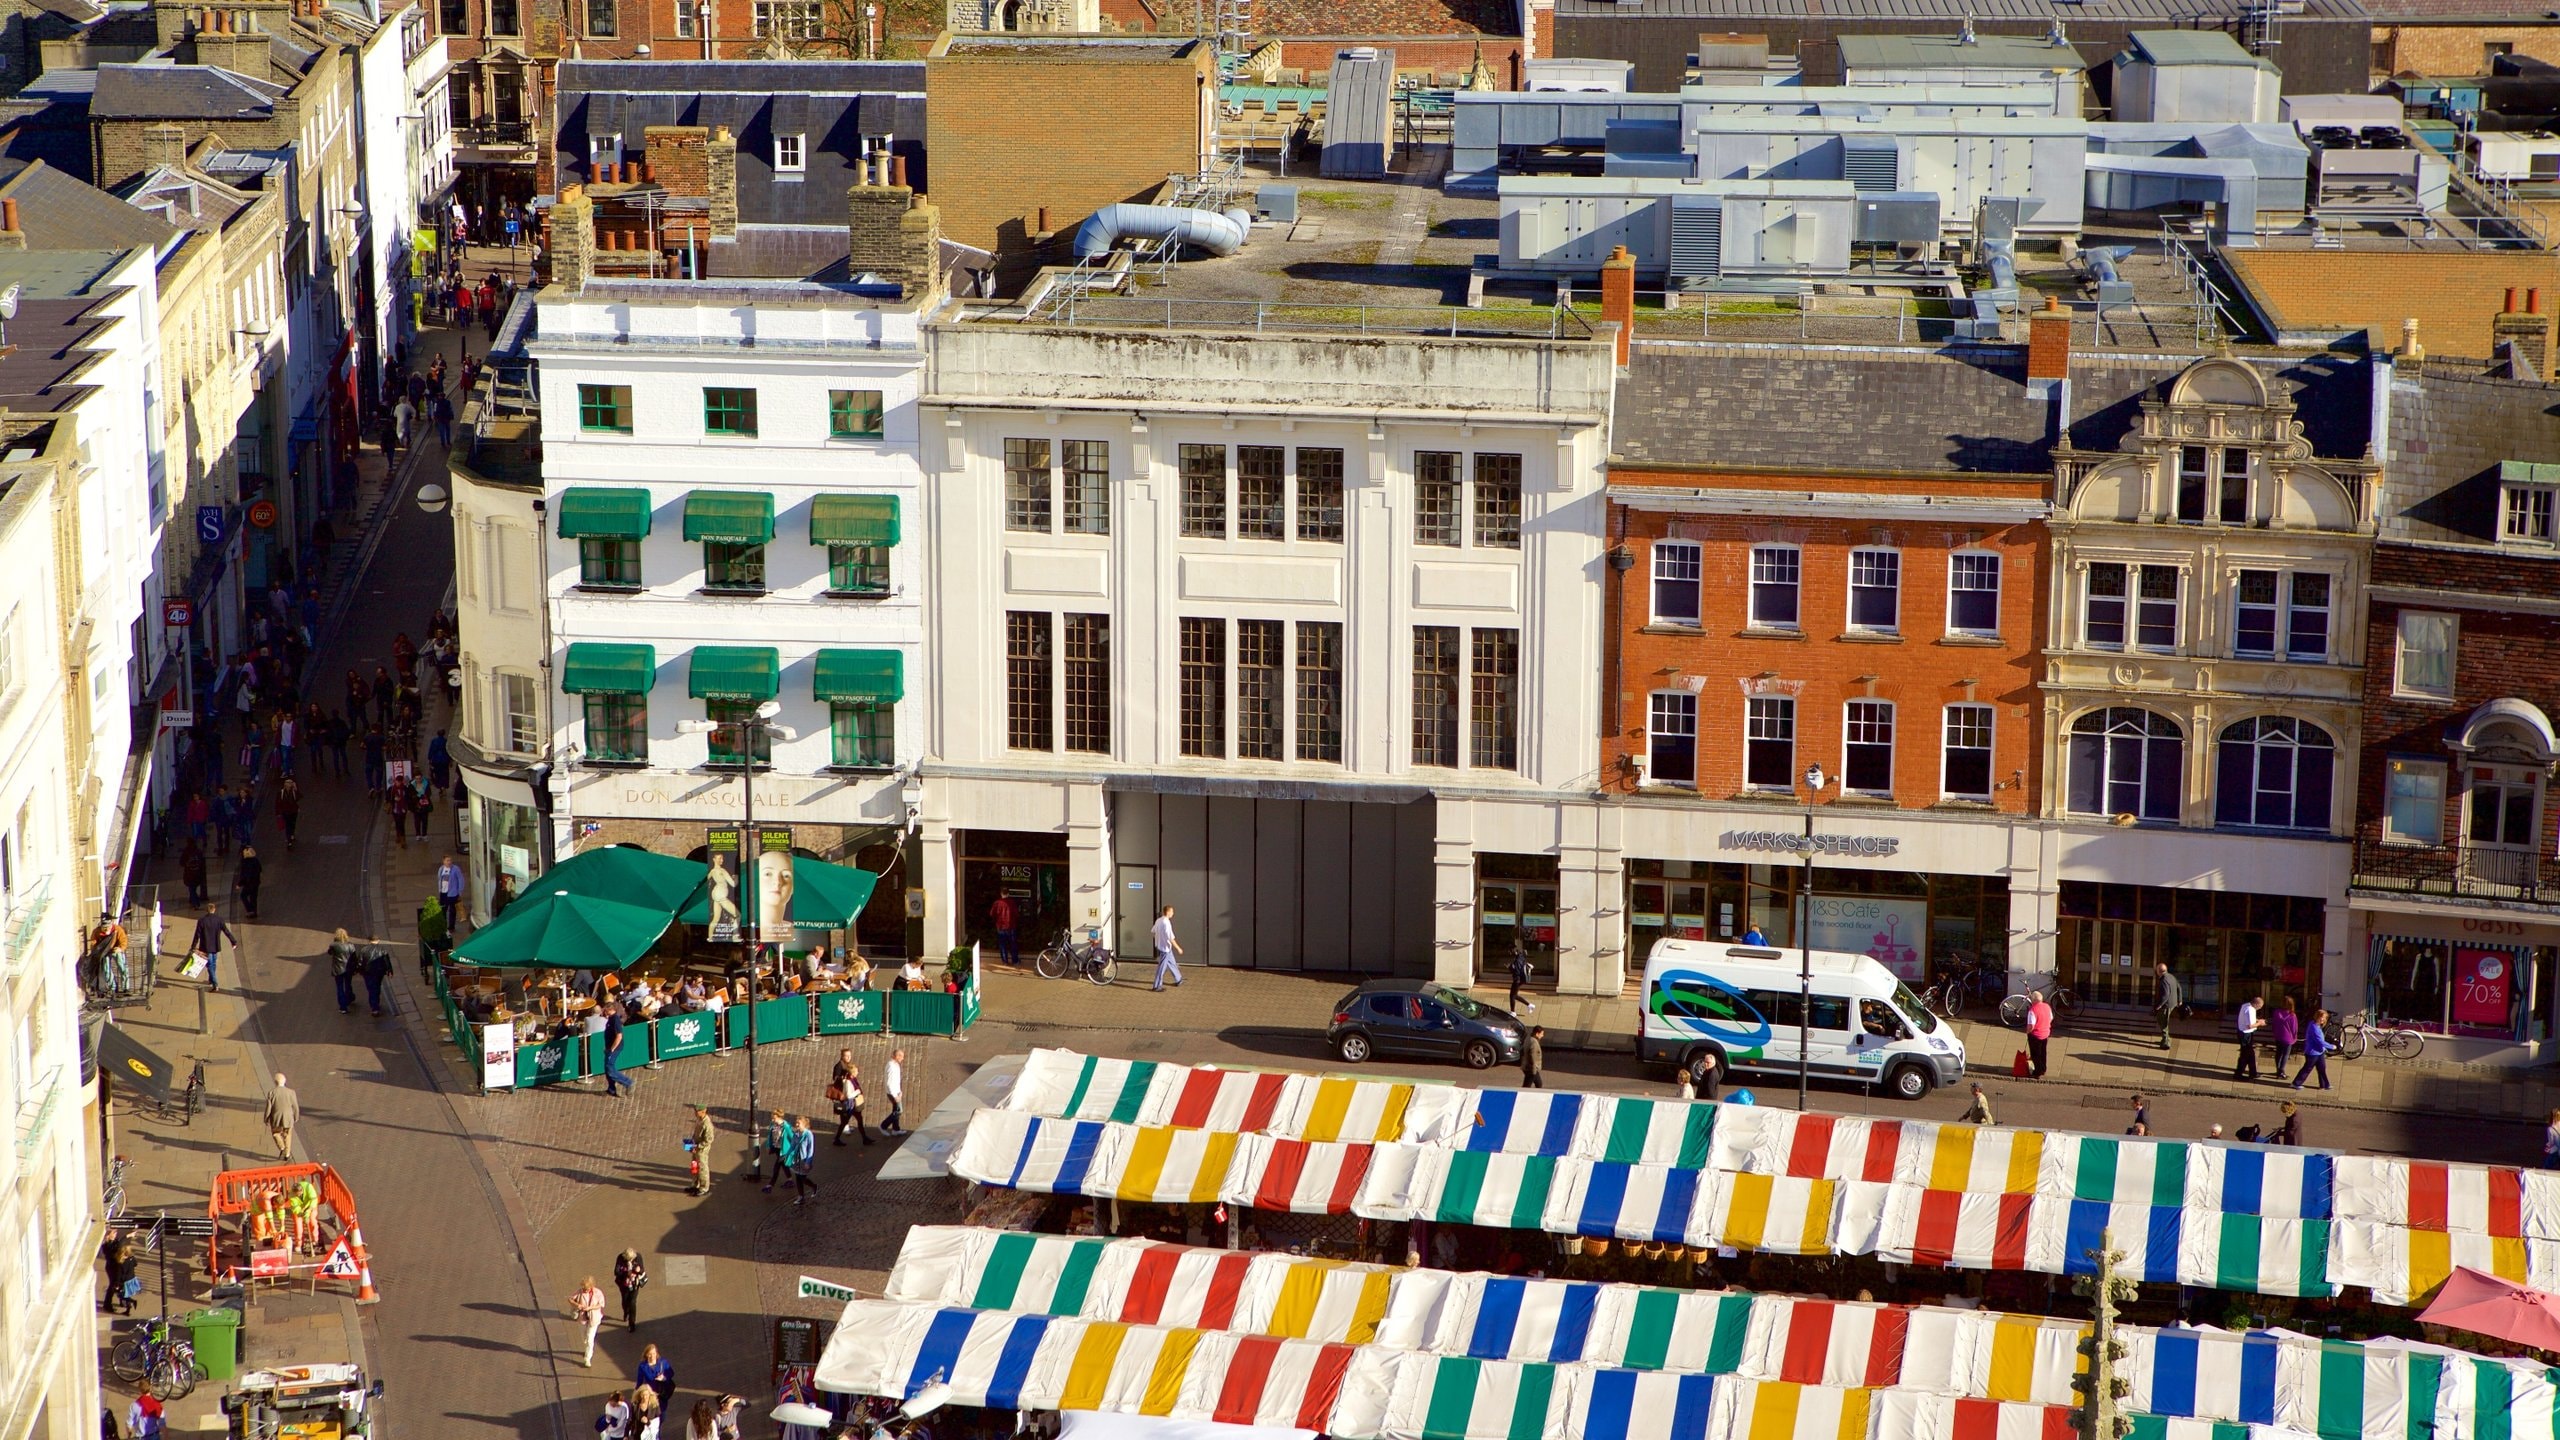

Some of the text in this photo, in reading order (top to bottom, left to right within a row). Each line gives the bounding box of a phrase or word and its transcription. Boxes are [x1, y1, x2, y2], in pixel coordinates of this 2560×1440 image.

[485, 152, 506, 160] JACK
[203, 516, 219, 540] S
[448, 668, 462, 686] 3
[626, 789, 789, 808] DON PASQUALE
[1731, 831, 1797, 849] MARKS
[1814, 833, 1899, 853] SPENCER
[1005, 866, 1031, 877] M&S
[1801, 899, 1880, 919] M&S Café
[1812, 919, 1825, 927] the
[1826, 920, 1854, 929] second
[1855, 921, 1873, 930] floor
[2462, 983, 2502, 1003] 70%
[802, 1282, 853, 1302] OLIVES
